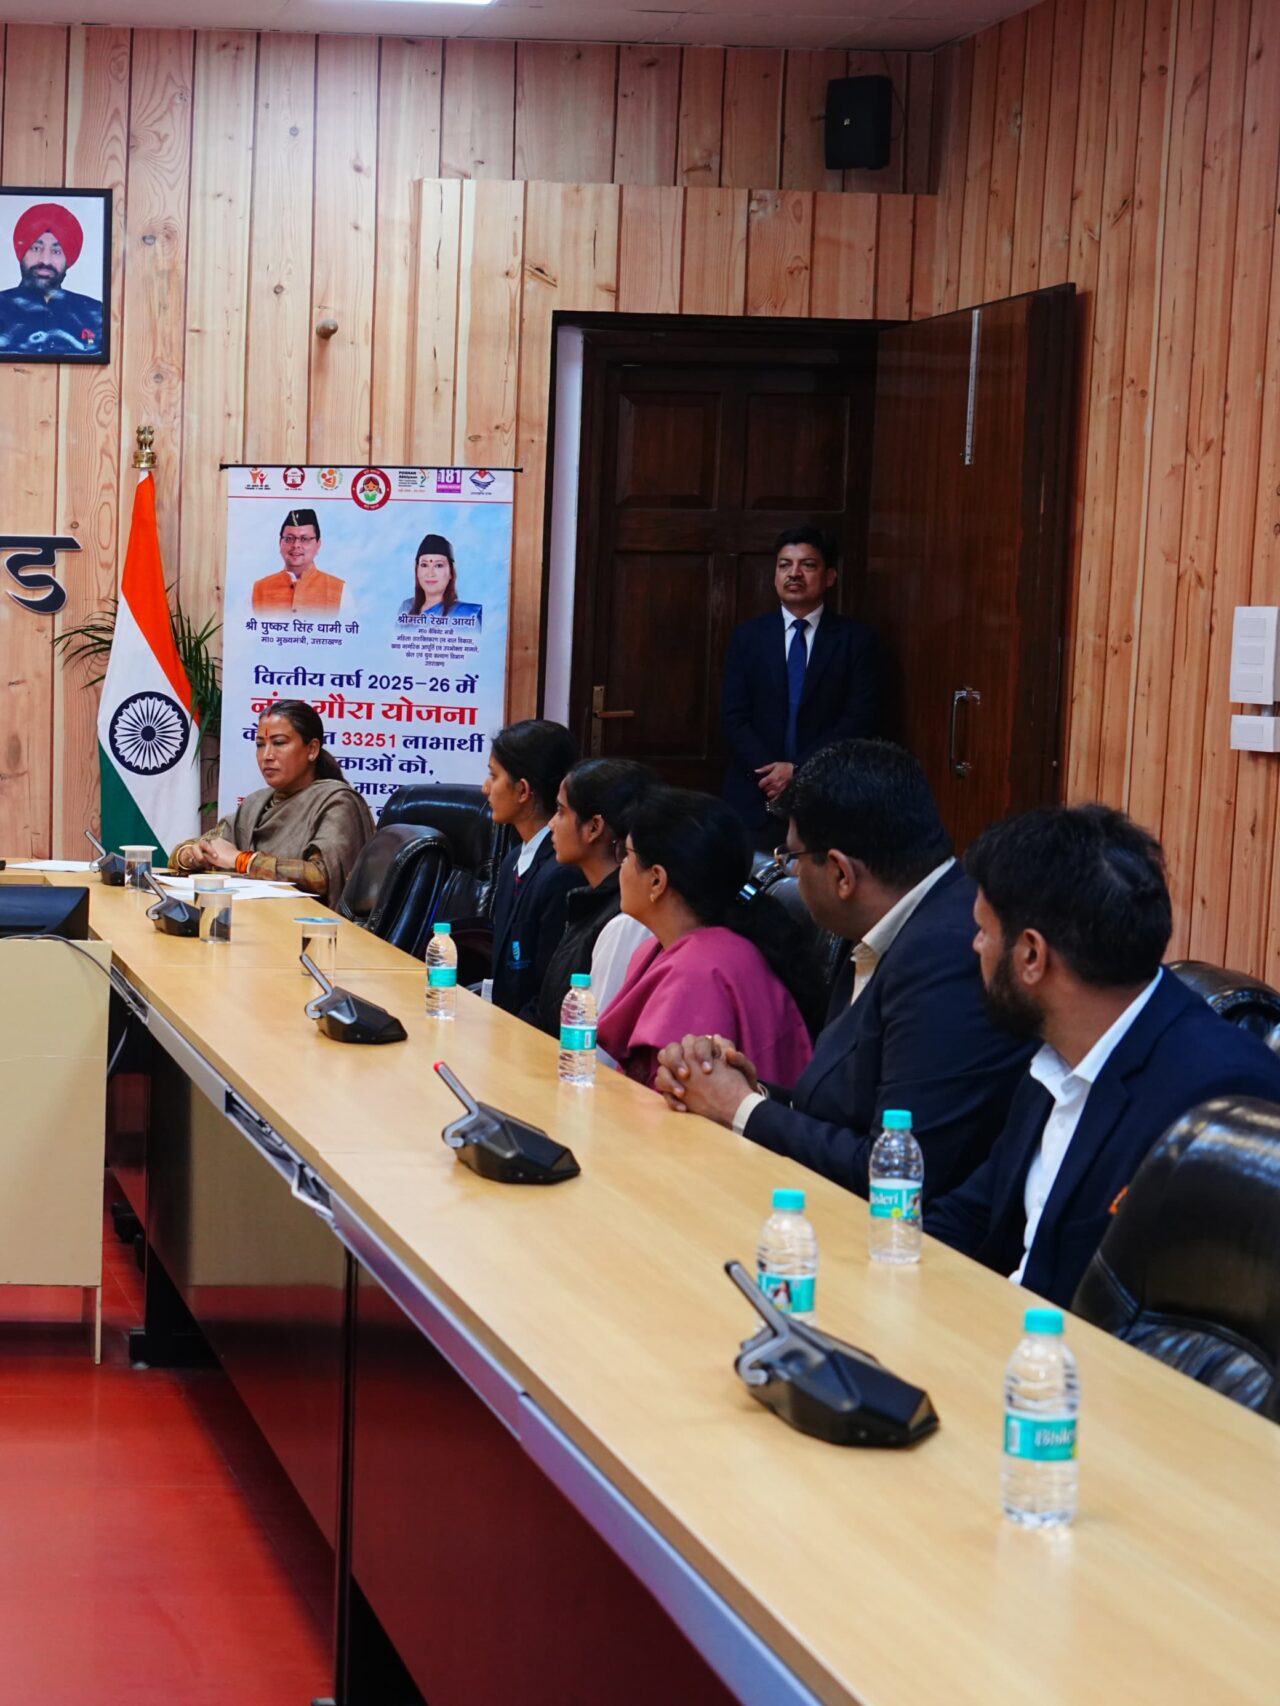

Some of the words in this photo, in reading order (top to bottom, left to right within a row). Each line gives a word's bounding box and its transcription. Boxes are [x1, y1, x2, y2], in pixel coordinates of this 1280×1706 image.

[439, 469, 461, 483] 181
[245, 617, 257, 630] श्री
[261, 621, 289, 634] पुष्कर
[293, 619, 314, 633] सिंह
[317, 620, 341, 633] धामी
[345, 621, 359, 634] जी
[398, 613, 427, 624] श्रीमती
[431, 614, 448, 625] रेखा
[452, 615, 476, 626] आर्या
[254, 665, 325, 686] वित्तीय
[330, 668, 363, 688] वर्ष
[368, 675, 450, 692] 2025-26
[455, 673, 480, 693] में
[311, 693, 375, 720] गौरा
[381, 696, 478, 725] योजना
[341, 732, 396, 748] 33251
[402, 733, 485, 752] लाभार्थी
[398, 755, 433, 775] को,
